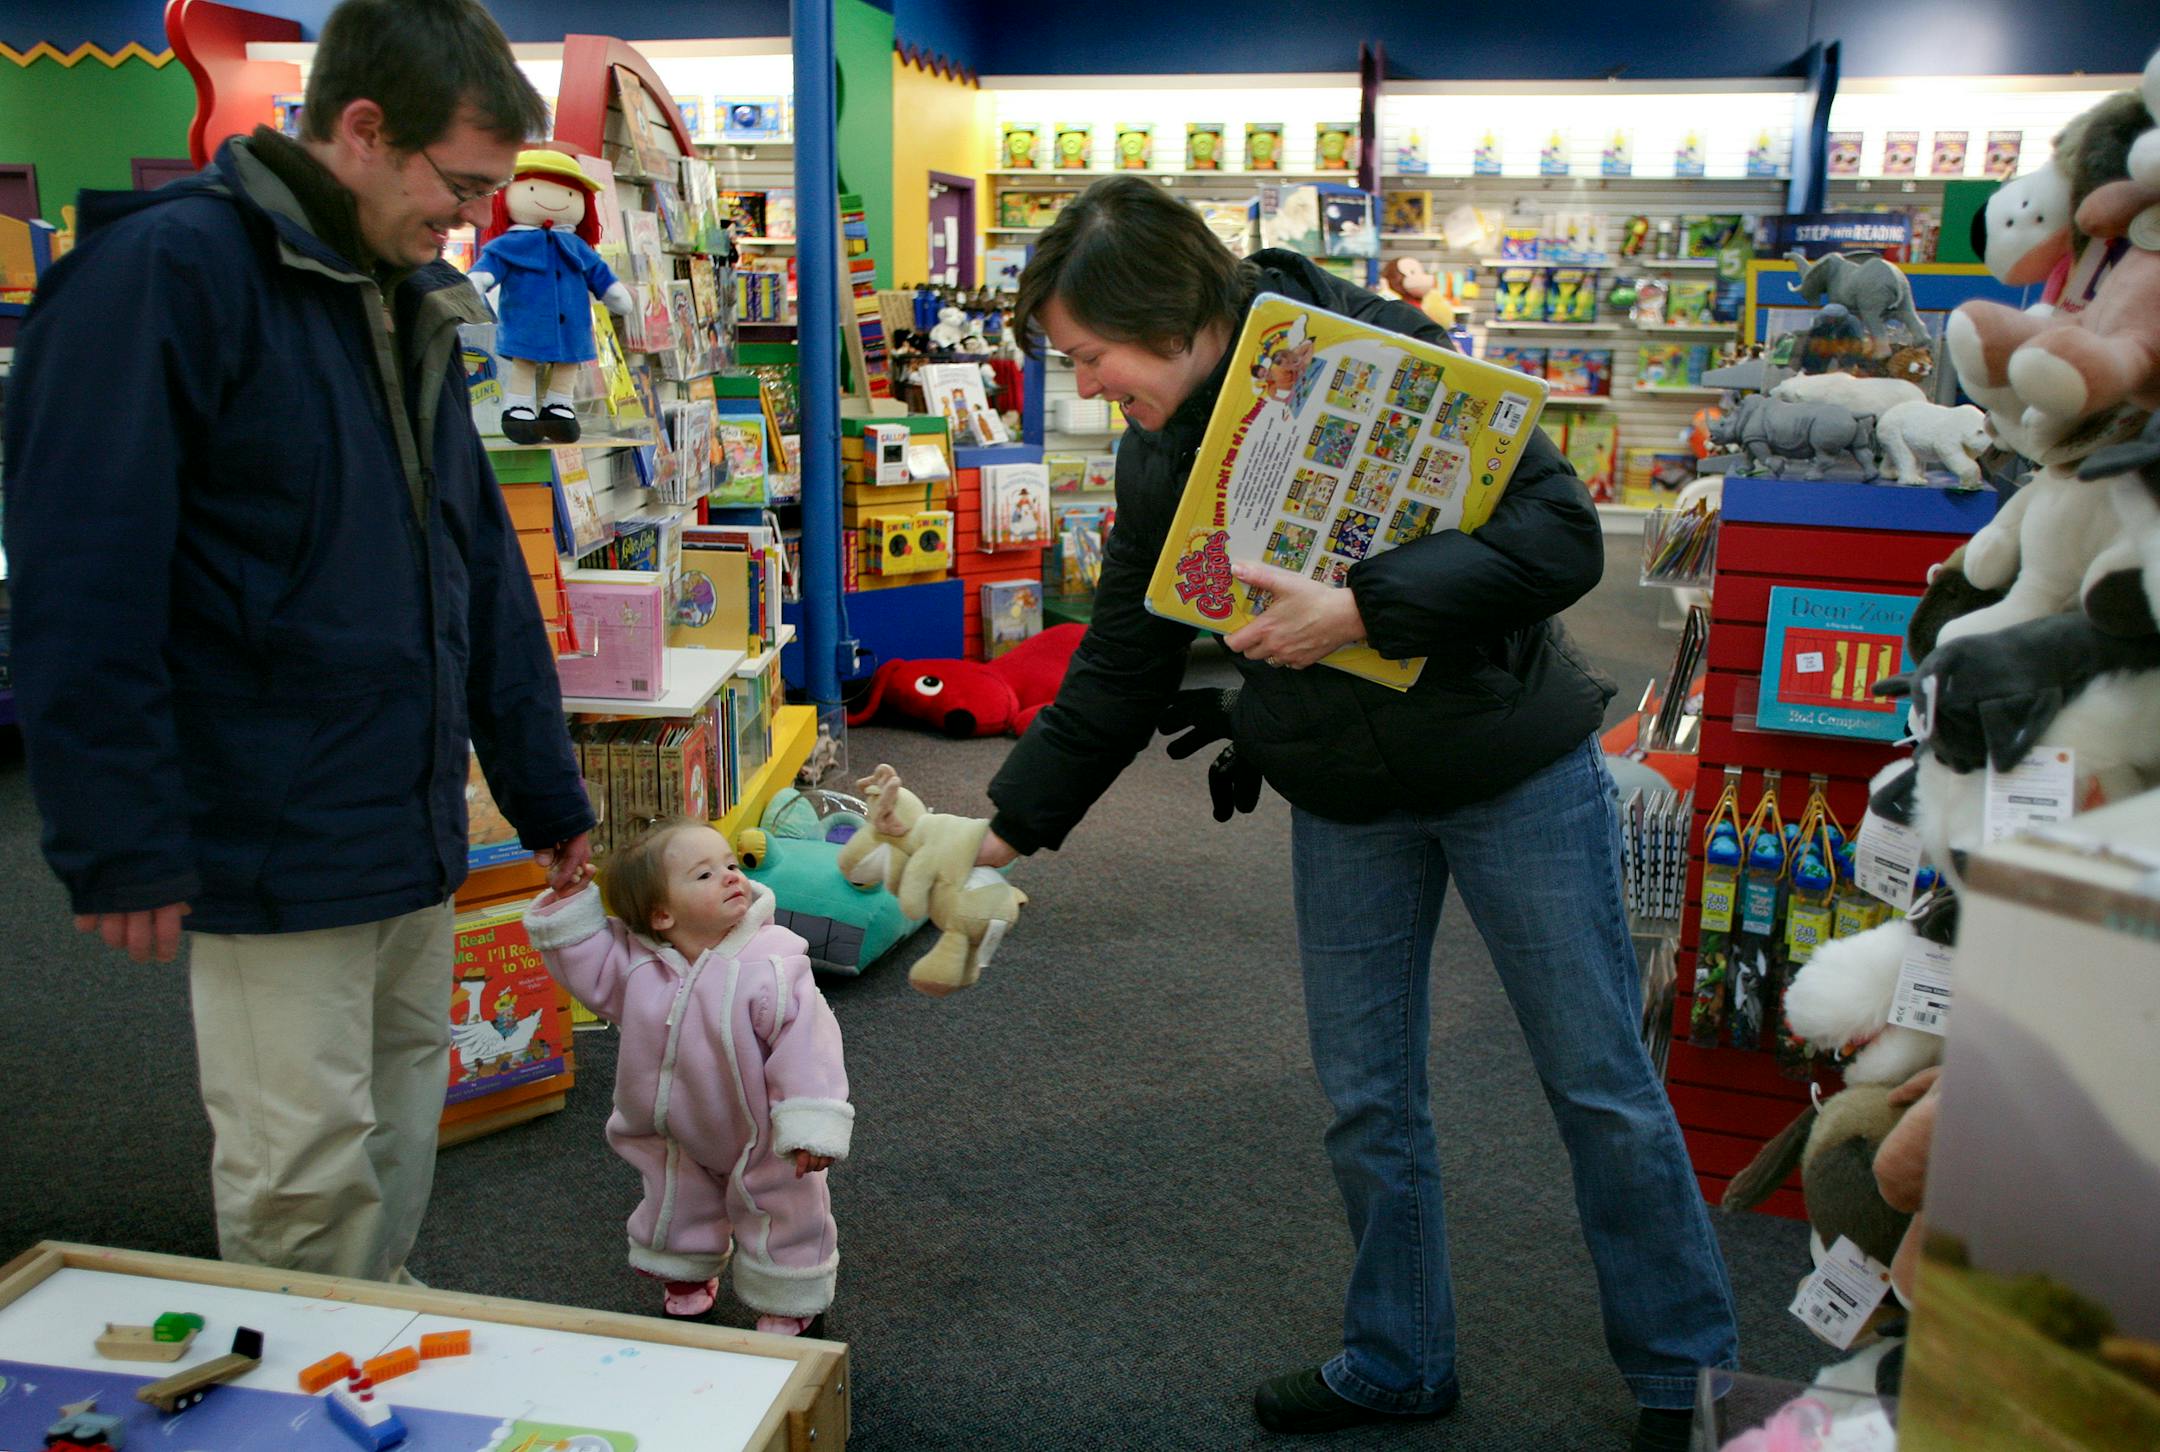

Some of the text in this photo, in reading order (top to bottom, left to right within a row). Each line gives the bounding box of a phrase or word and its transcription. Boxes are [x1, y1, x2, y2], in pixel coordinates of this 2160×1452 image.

[1796, 225, 1829, 241] STEP
[1854, 225, 1905, 241] READING
[471, 384, 497, 401] ELINE
[1232, 432, 1243, 446] of
[1221, 447, 1239, 468] Fun
[1216, 470, 1232, 491] Felt
[1212, 496, 1226, 527] Have
[1175, 551, 1206, 605] Felt
[1196, 530, 1236, 620] Creations
[1791, 596, 1905, 625] Dear Zoo
[1789, 710, 1815, 724] Rod
[460, 928, 495, 948] Read
[510, 944, 539, 957] Rea
[503, 962, 516, 974] to
